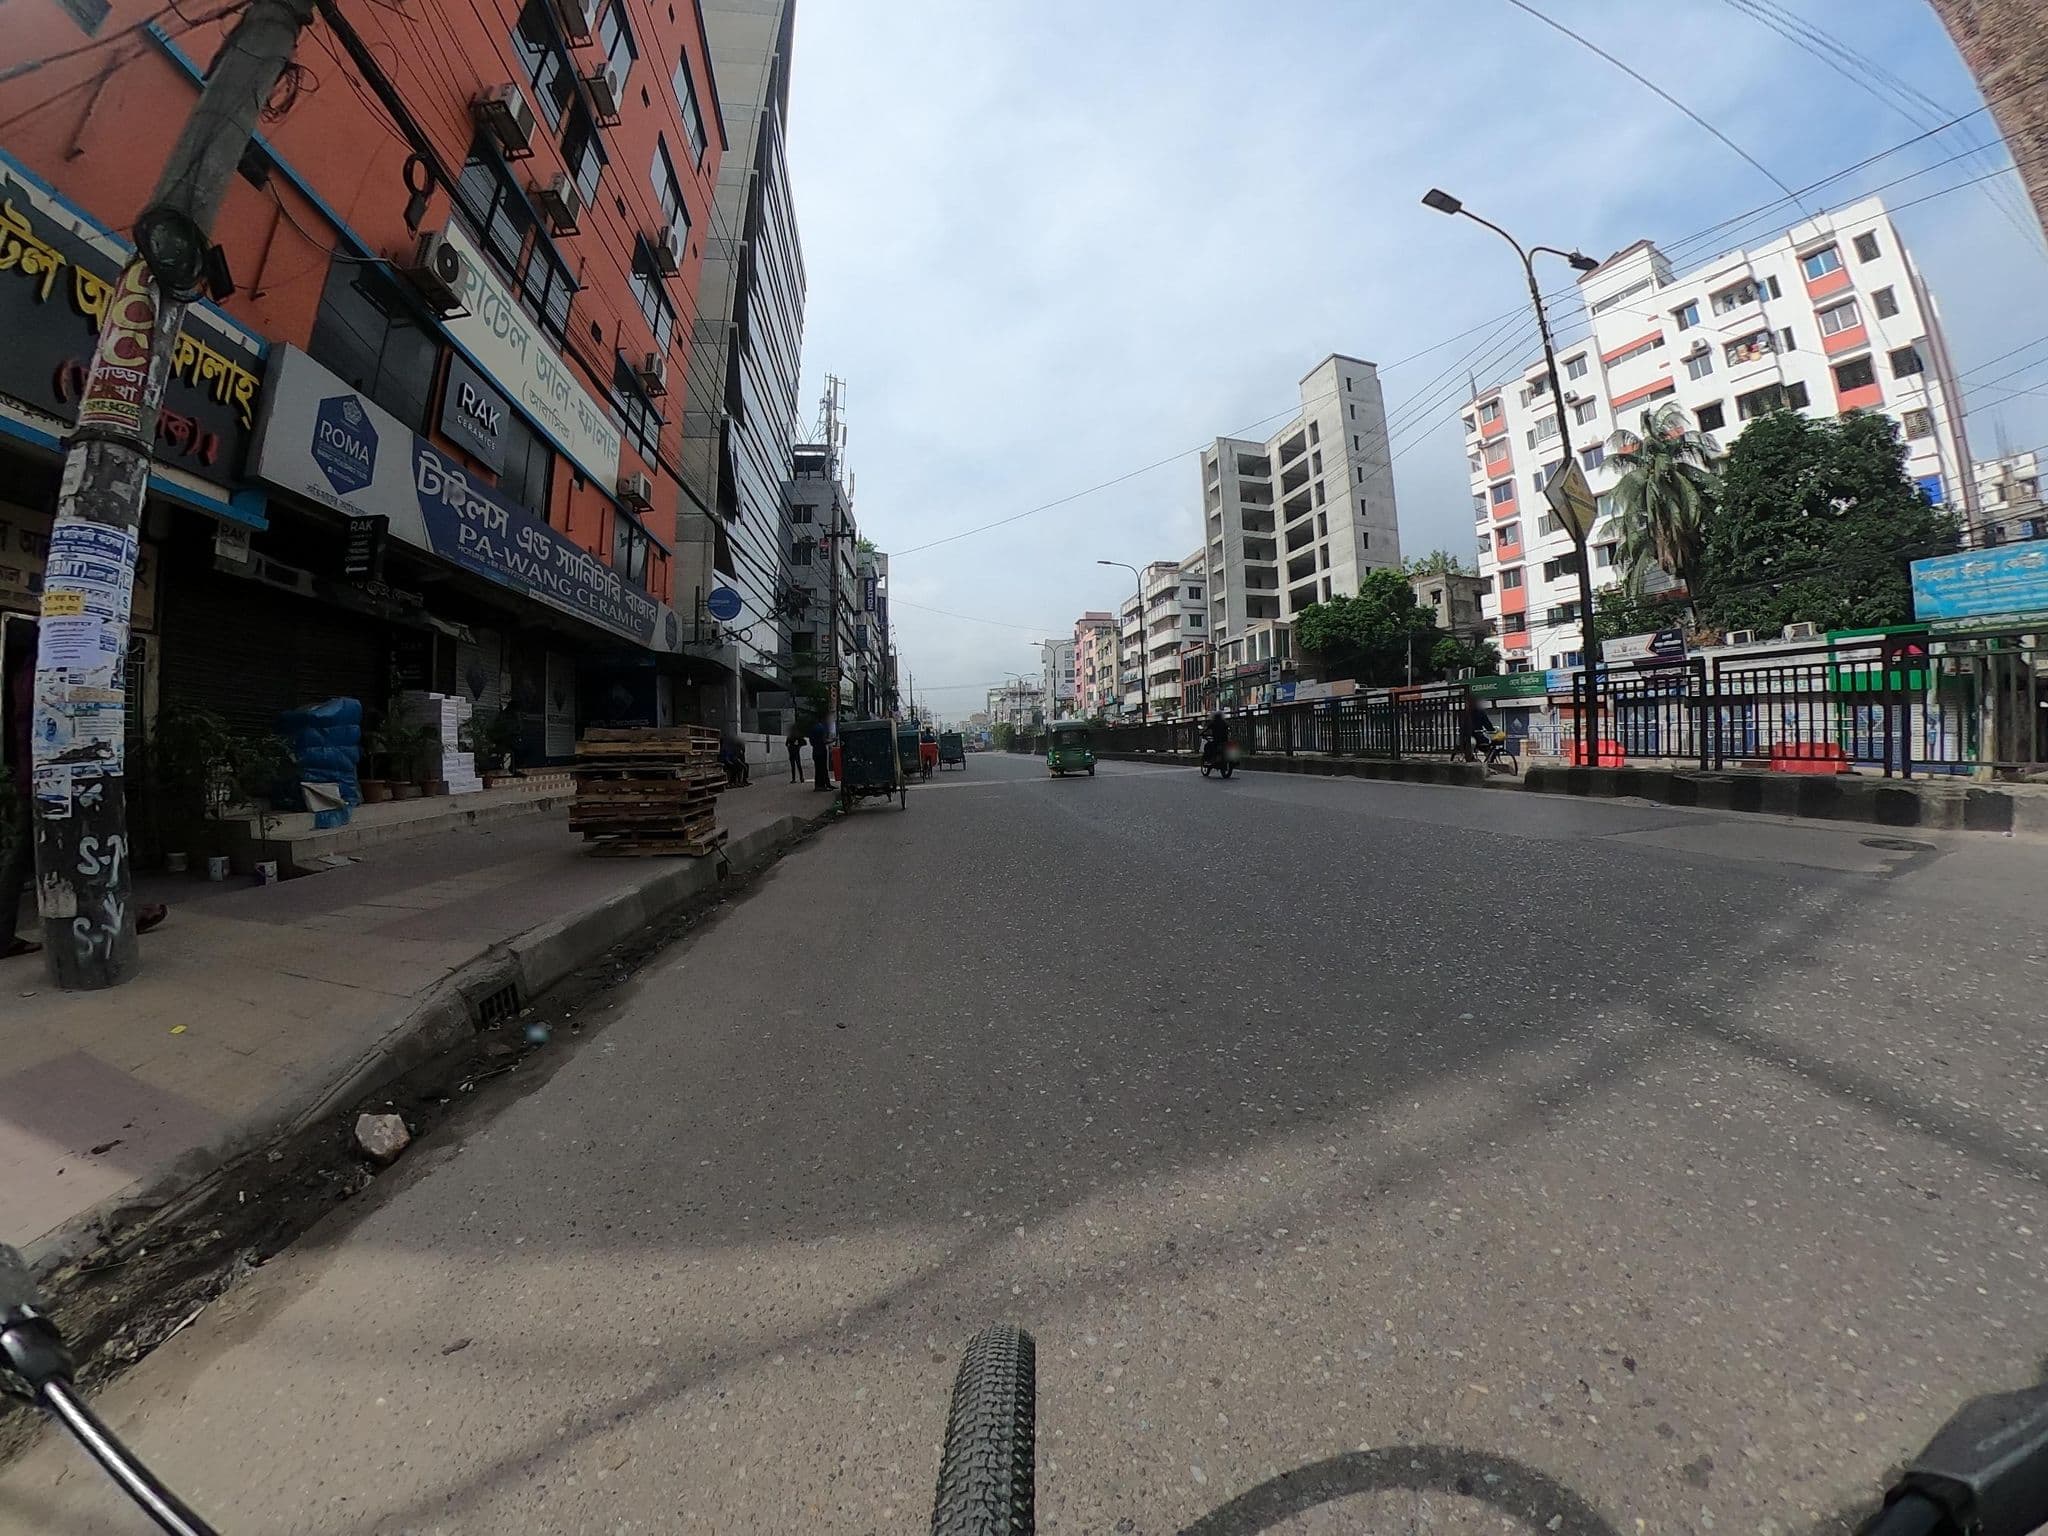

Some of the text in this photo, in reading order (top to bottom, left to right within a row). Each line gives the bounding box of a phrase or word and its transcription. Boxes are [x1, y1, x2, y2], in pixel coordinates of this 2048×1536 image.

[457, 415, 496, 450] CERAMICS
[461, 382, 501, 436] RAK
[320, 419, 369, 466] ROMA
[350, 519, 374, 532] RAK
[458, 523, 572, 596] PA-WANG
[576, 588, 643, 633] CERAMIC
[555, 544, 622, 604] স্যানিটারি
[625, 588, 657, 624] বাজার
[1471, 682, 1498, 692] CERAMIC
